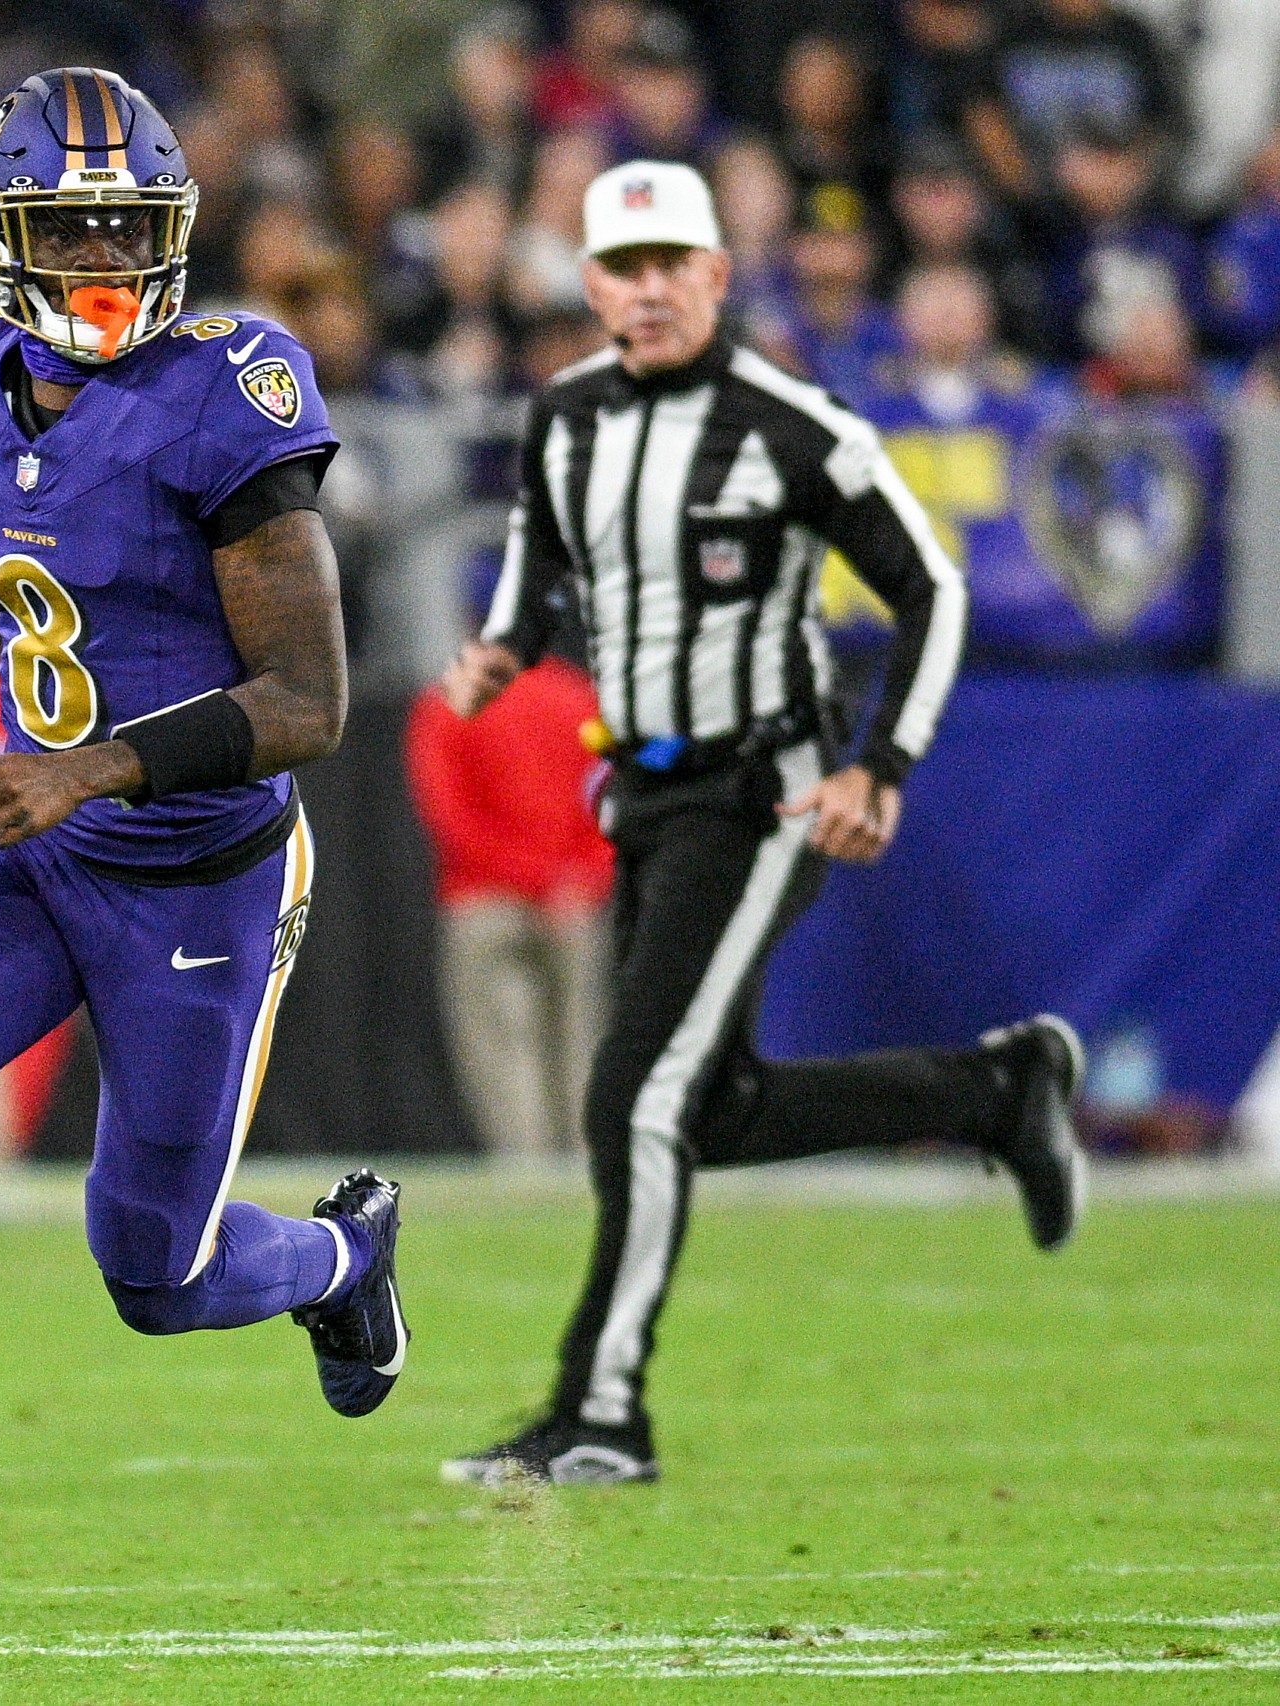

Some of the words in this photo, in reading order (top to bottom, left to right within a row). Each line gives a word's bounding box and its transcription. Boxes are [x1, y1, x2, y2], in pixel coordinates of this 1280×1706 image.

[78, 171, 118, 183] RAVENS
[170, 316, 239, 342] 8
[243, 363, 284, 382] RAVENS
[1, 527, 58, 548] RAVENS
